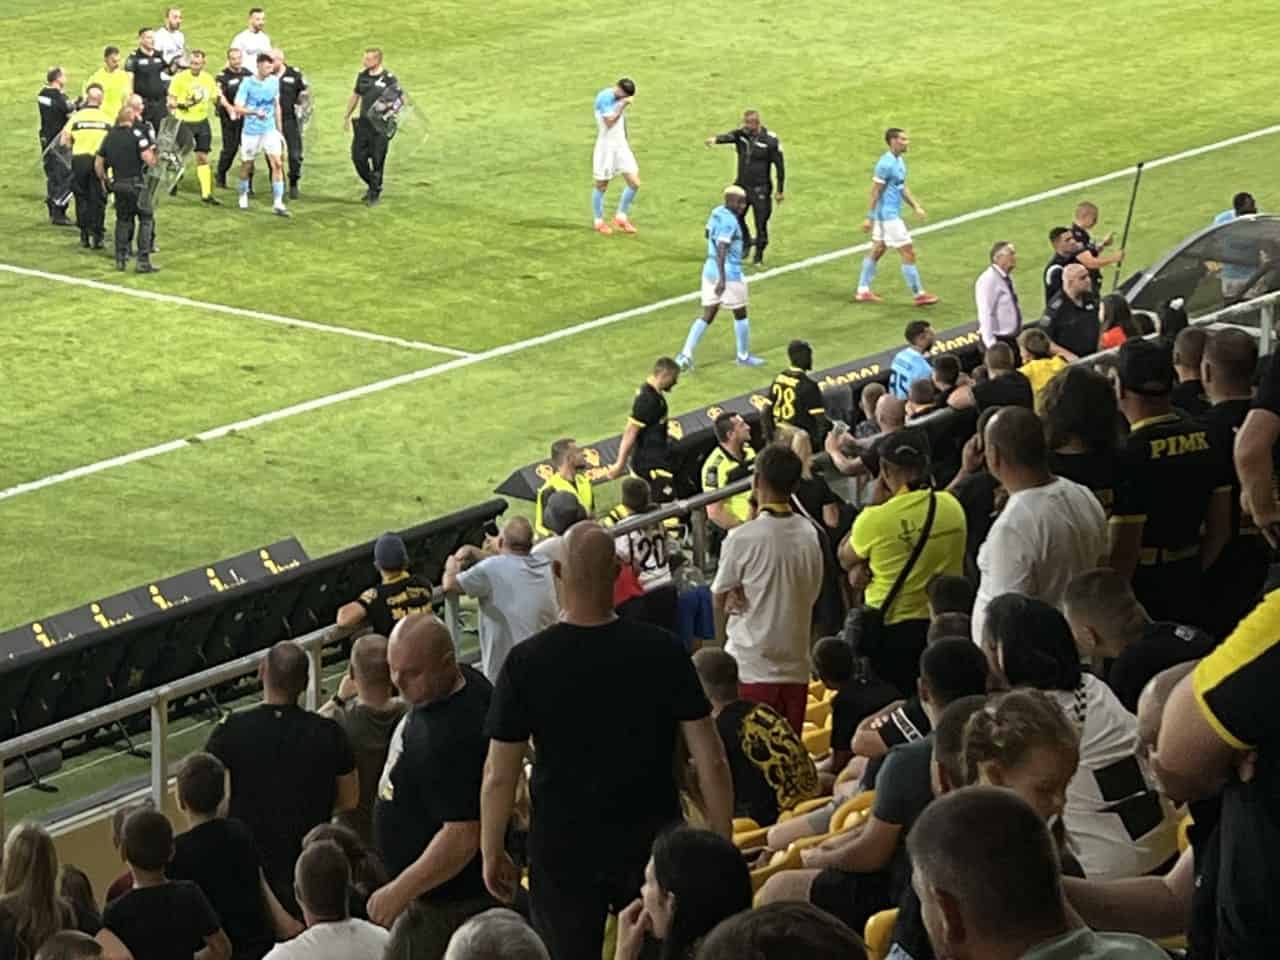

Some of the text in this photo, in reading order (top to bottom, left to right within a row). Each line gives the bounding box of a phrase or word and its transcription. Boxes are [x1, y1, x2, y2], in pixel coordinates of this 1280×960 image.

[773, 384, 796, 419] 28
[1150, 432, 1210, 459] PIMK
[638, 534, 665, 571] 20
